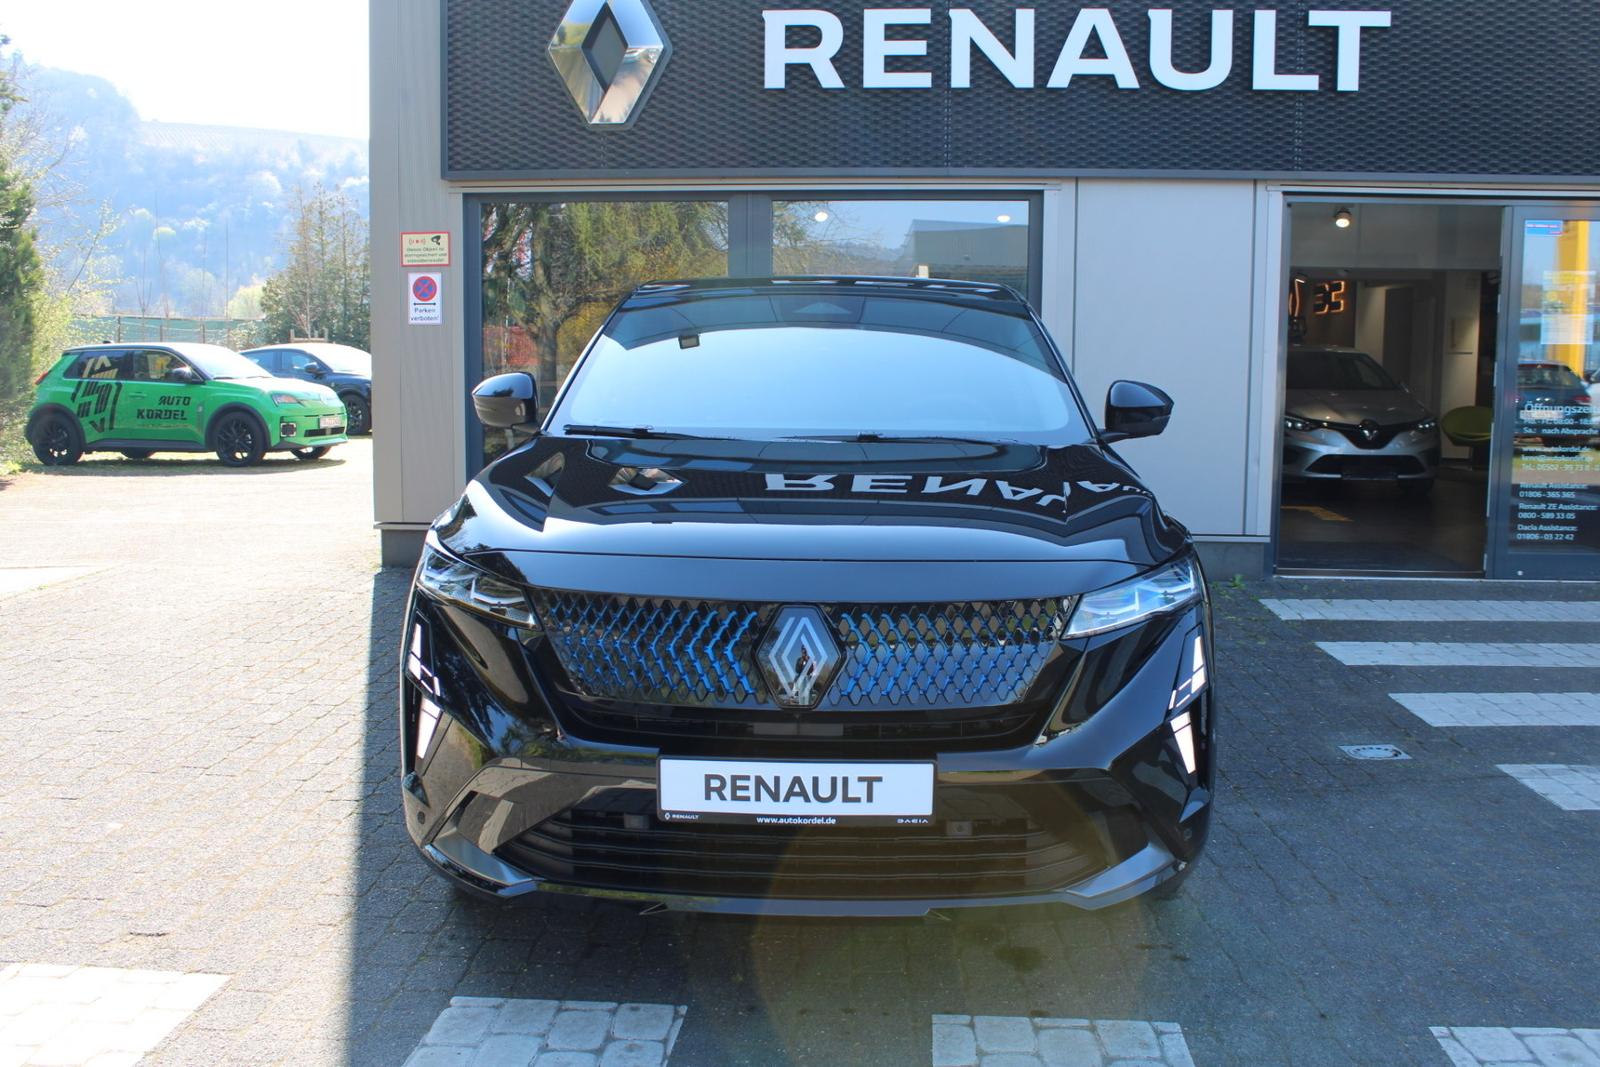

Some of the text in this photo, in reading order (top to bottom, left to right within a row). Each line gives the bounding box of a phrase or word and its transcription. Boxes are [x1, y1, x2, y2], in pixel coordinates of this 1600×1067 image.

[762, 8, 1393, 92] RENAULT
[159, 396, 191, 406] AUTO
[137, 409, 187, 420] KORDEL
[1518, 502, 1546, 510] Renault
[704, 773, 883, 803] RENAULT
[756, 816, 836, 825] www.autokordel.de
